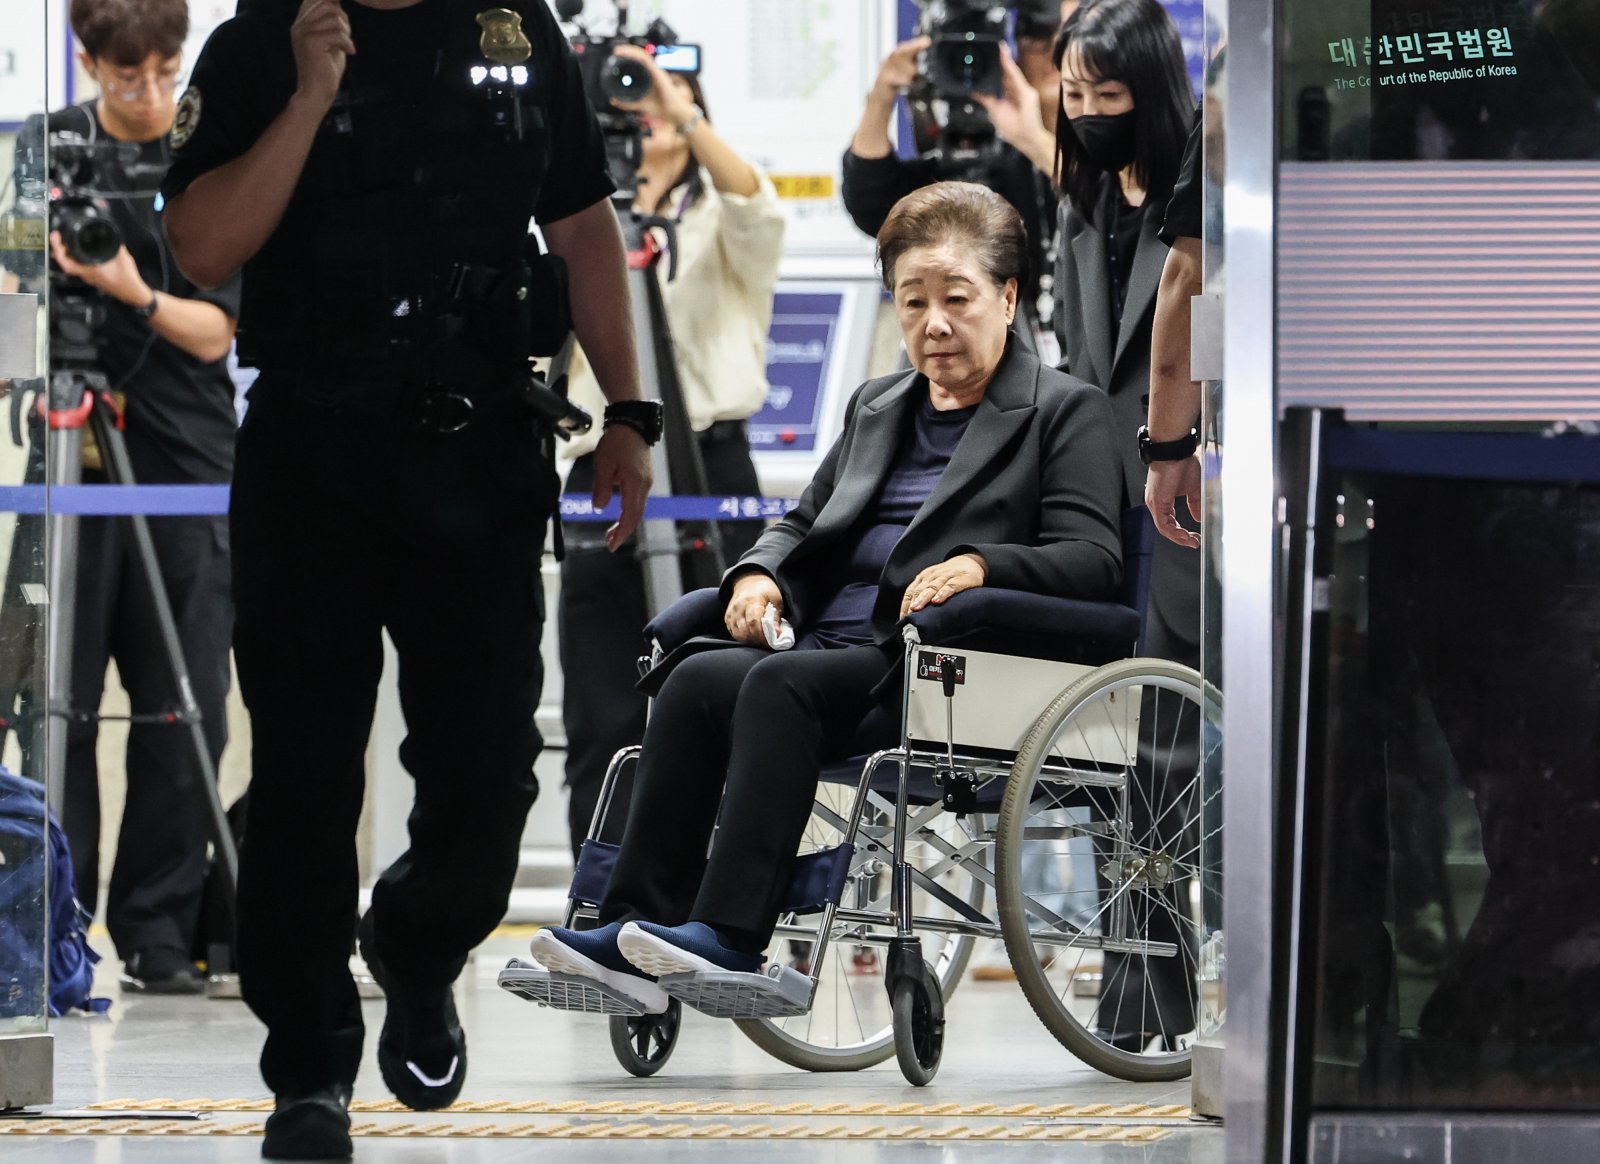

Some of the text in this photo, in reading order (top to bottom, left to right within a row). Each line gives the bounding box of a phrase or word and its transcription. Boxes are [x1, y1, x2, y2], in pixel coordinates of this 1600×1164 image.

[1334, 77, 1356, 90] The
[1396, 72, 1407, 85] of
[1408, 71, 1427, 84] the
[1428, 67, 1474, 83] Republic
[1475, 66, 1486, 78] of
[1488, 65, 1517, 76] Korea
